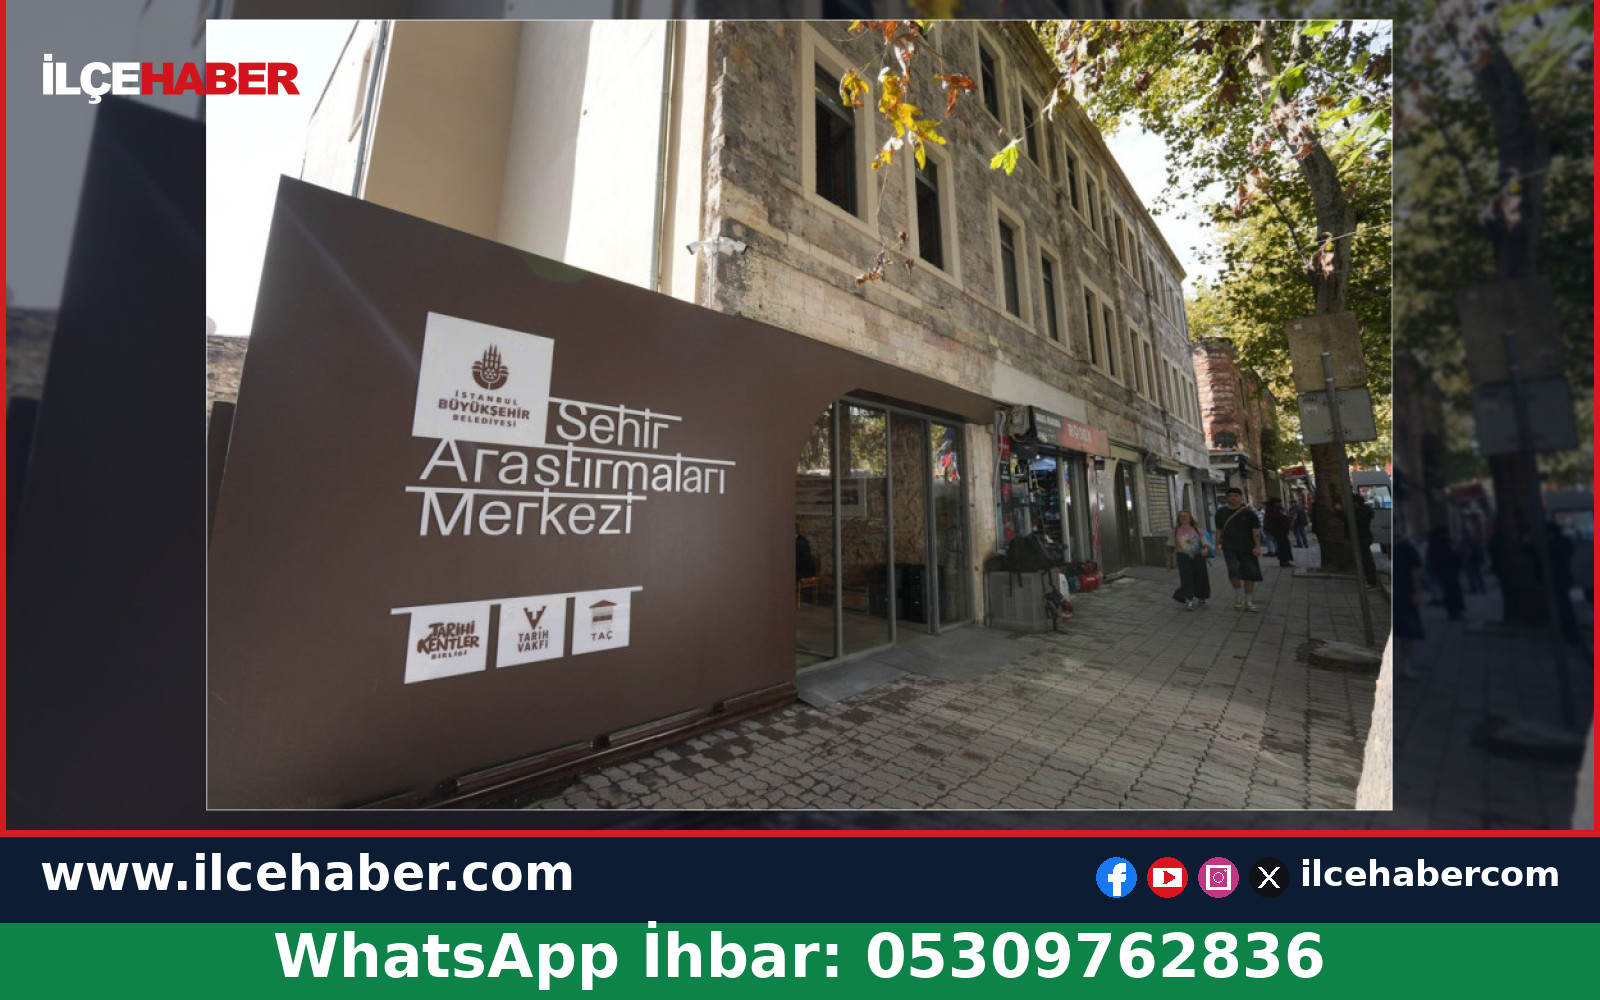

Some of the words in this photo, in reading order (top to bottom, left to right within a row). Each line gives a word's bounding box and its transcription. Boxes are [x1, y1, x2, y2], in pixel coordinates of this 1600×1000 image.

[455, 389, 518, 406] İSTANBUL
[438, 398, 530, 420] BÜYÜKŞEHİR
[452, 414, 517, 428] BELEDİYESİ
[420, 488, 632, 536] Merkezi
[518, 626, 549, 642] TARİH
[591, 630, 613, 641] TAÇ
[417, 633, 480, 655] KENTLER
[517, 639, 549, 653] VAKFI
